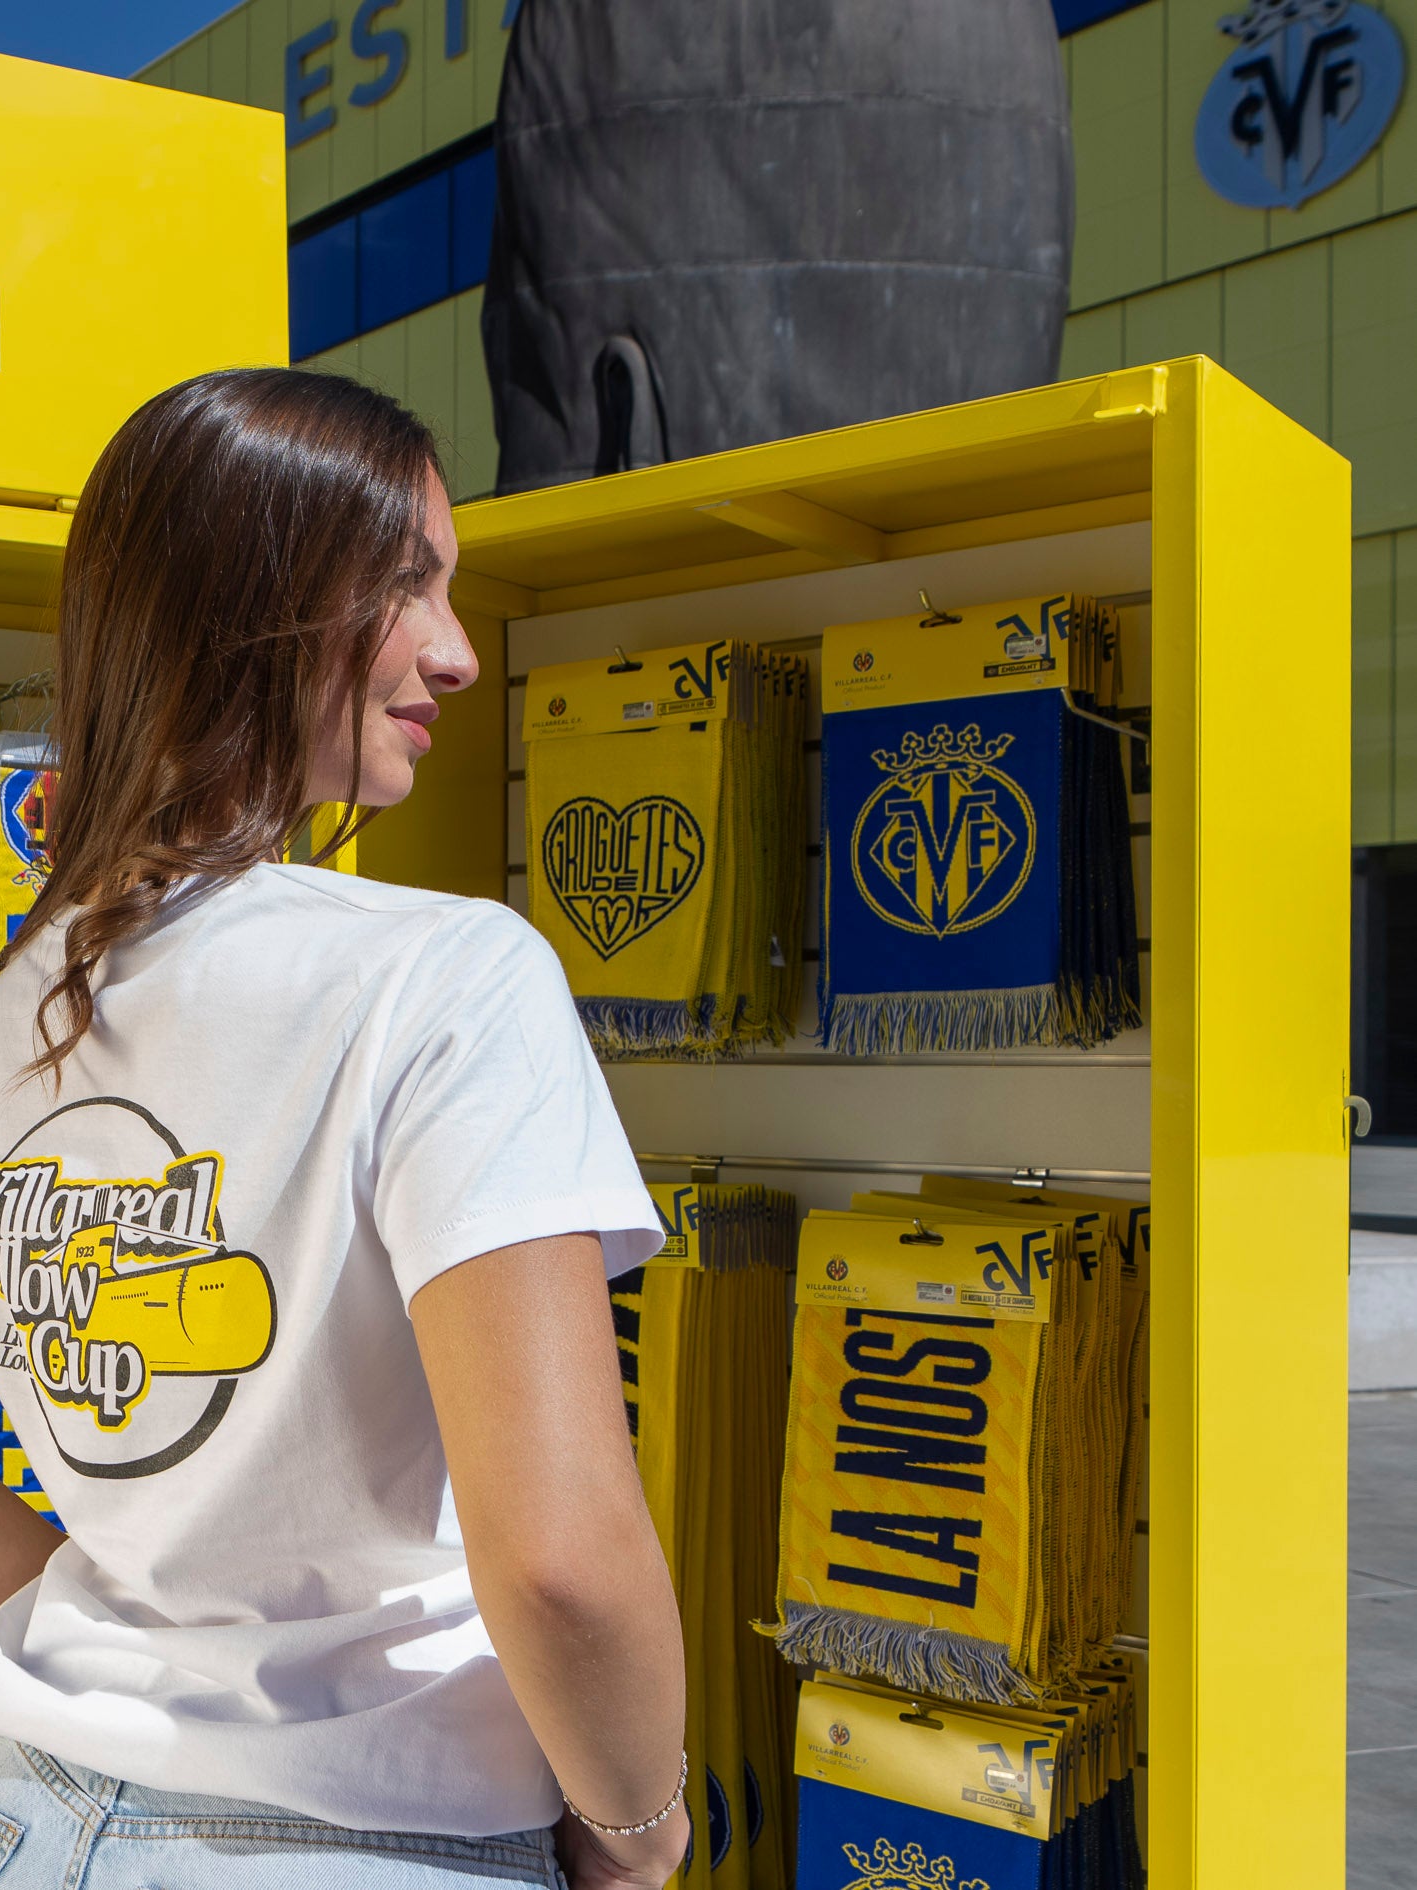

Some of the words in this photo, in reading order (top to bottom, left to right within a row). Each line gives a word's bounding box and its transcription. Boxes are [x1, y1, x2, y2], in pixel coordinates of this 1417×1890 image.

[591, 876, 638, 892] DE
[75, 1245, 95, 1259] 1923
[805, 1283, 852, 1292] VILLARREAL
[29, 1320, 144, 1416] Cup
[827, 1509, 982, 1610] LA
[807, 1743, 853, 1761] VILLARREAL
